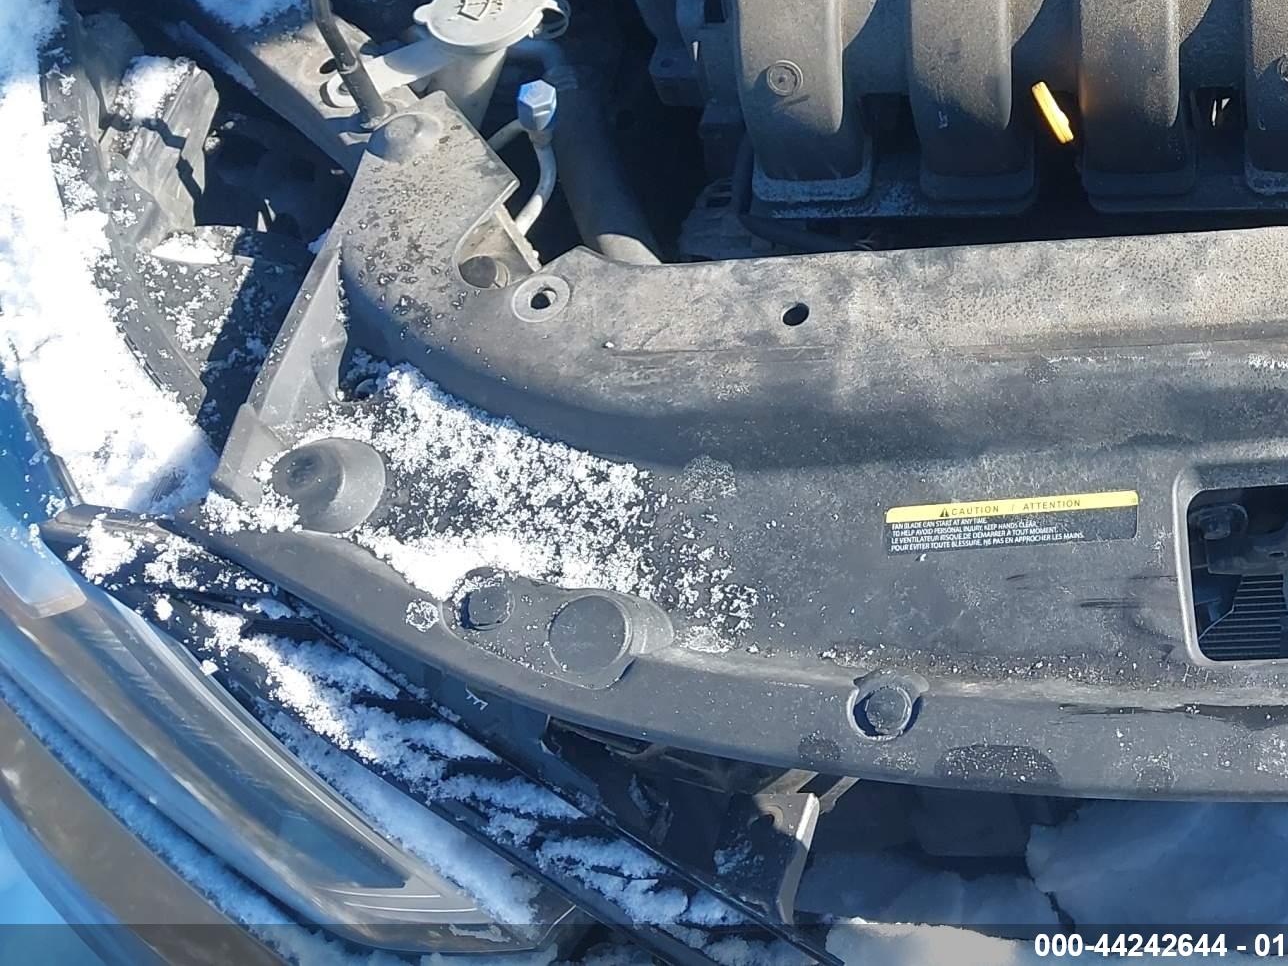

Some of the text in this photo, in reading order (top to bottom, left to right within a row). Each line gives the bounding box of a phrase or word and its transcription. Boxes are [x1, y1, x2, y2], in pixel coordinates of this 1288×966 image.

[951, 505, 999, 515] CAUTION
[1023, 500, 1081, 510] ATTENTION
[891, 544, 909, 552] POUR
[1015, 534, 1051, 543] APPROCHER
[900, 535, 939, 543] VENTILATEUR
